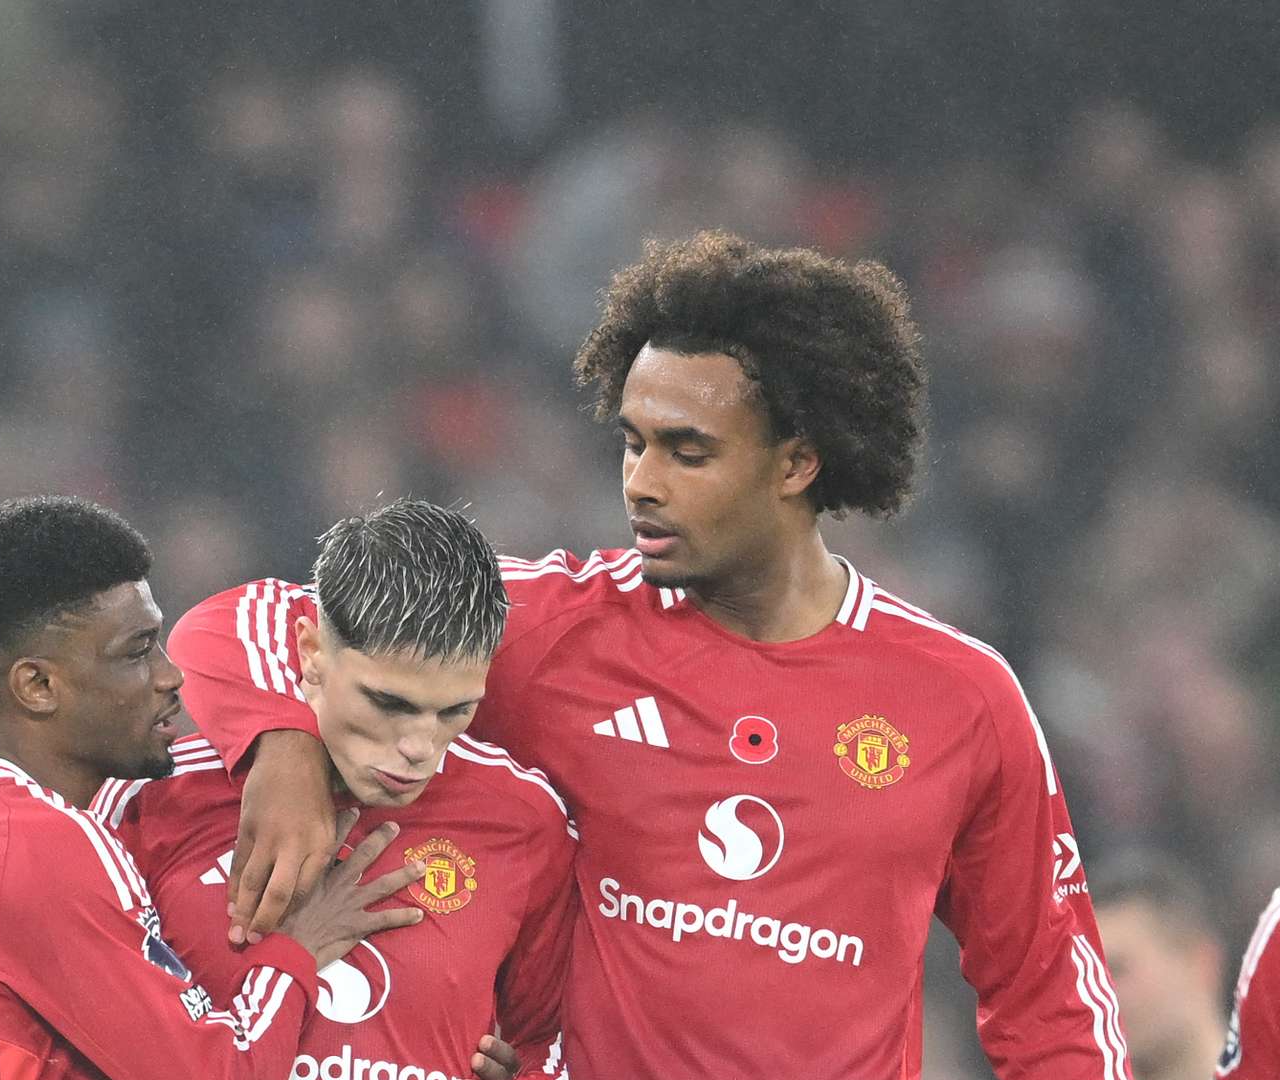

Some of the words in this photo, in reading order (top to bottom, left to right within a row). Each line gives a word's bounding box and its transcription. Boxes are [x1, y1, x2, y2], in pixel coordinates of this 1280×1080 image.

[842, 720, 905, 748] MANCHESTER
[850, 767, 894, 784] UNITED
[419, 892, 461, 909] UNITED
[598, 877, 864, 967] Snapdragon
